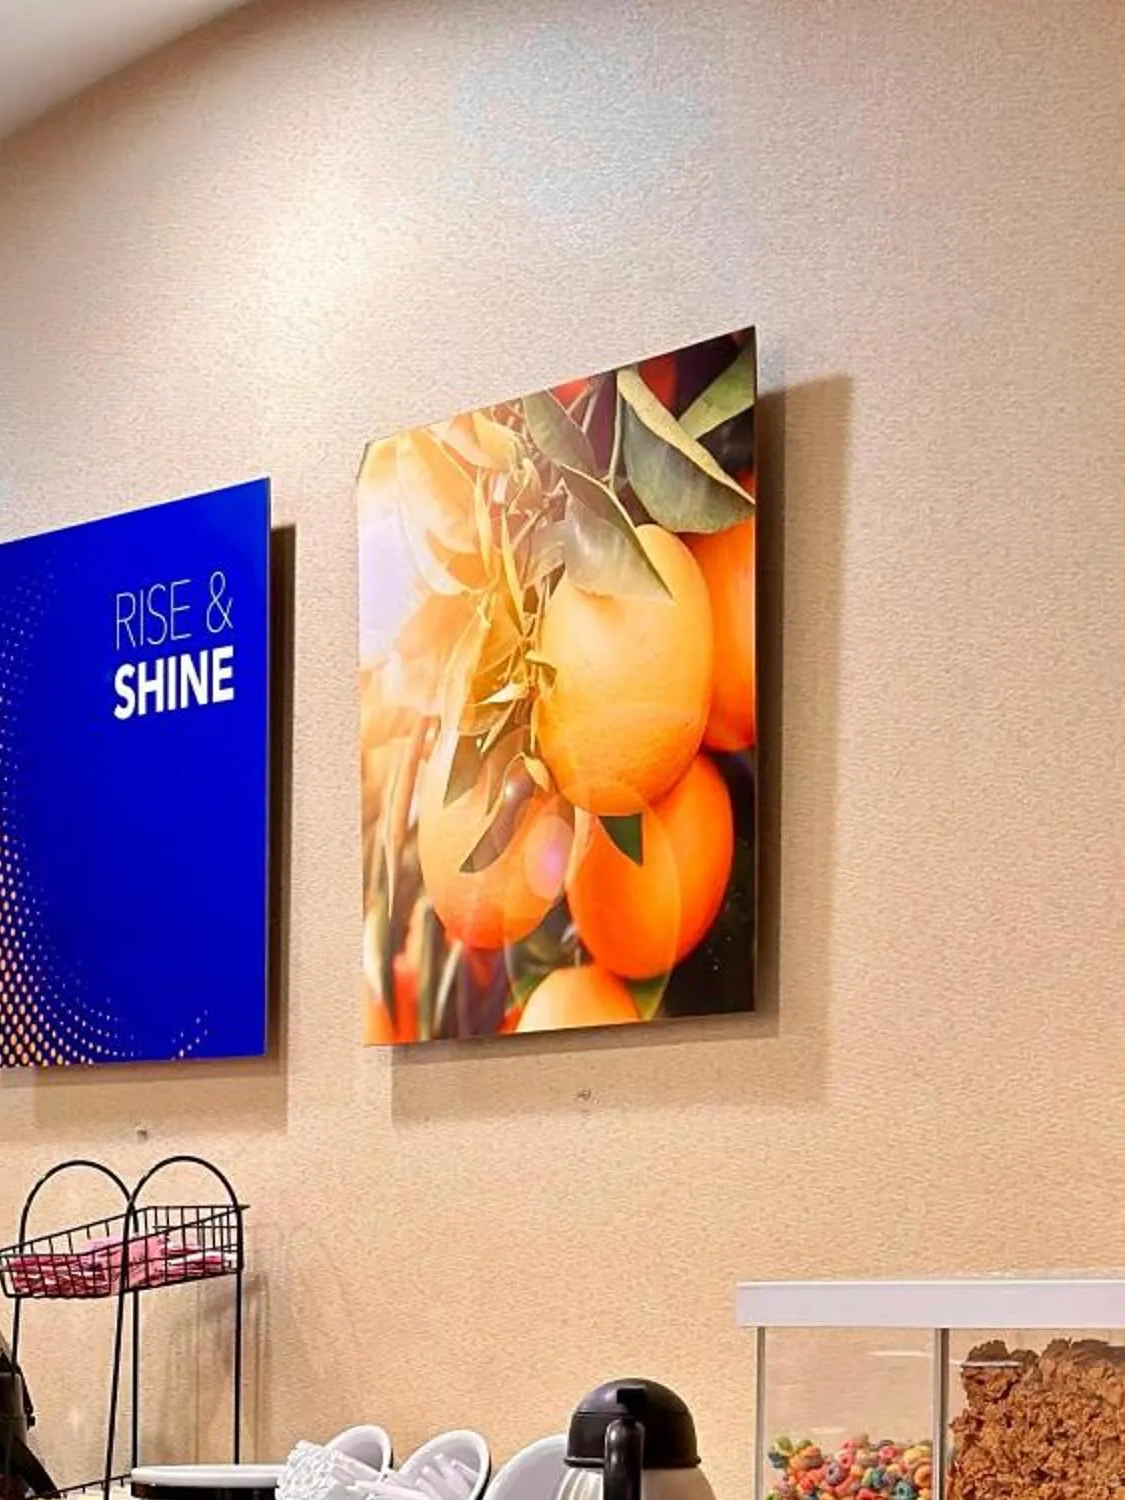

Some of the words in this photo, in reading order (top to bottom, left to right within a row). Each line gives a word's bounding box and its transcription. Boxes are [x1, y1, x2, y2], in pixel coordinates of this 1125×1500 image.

[116, 579, 192, 650] RISE
[206, 571, 234, 633] &
[114, 645, 234, 720] SHINE
